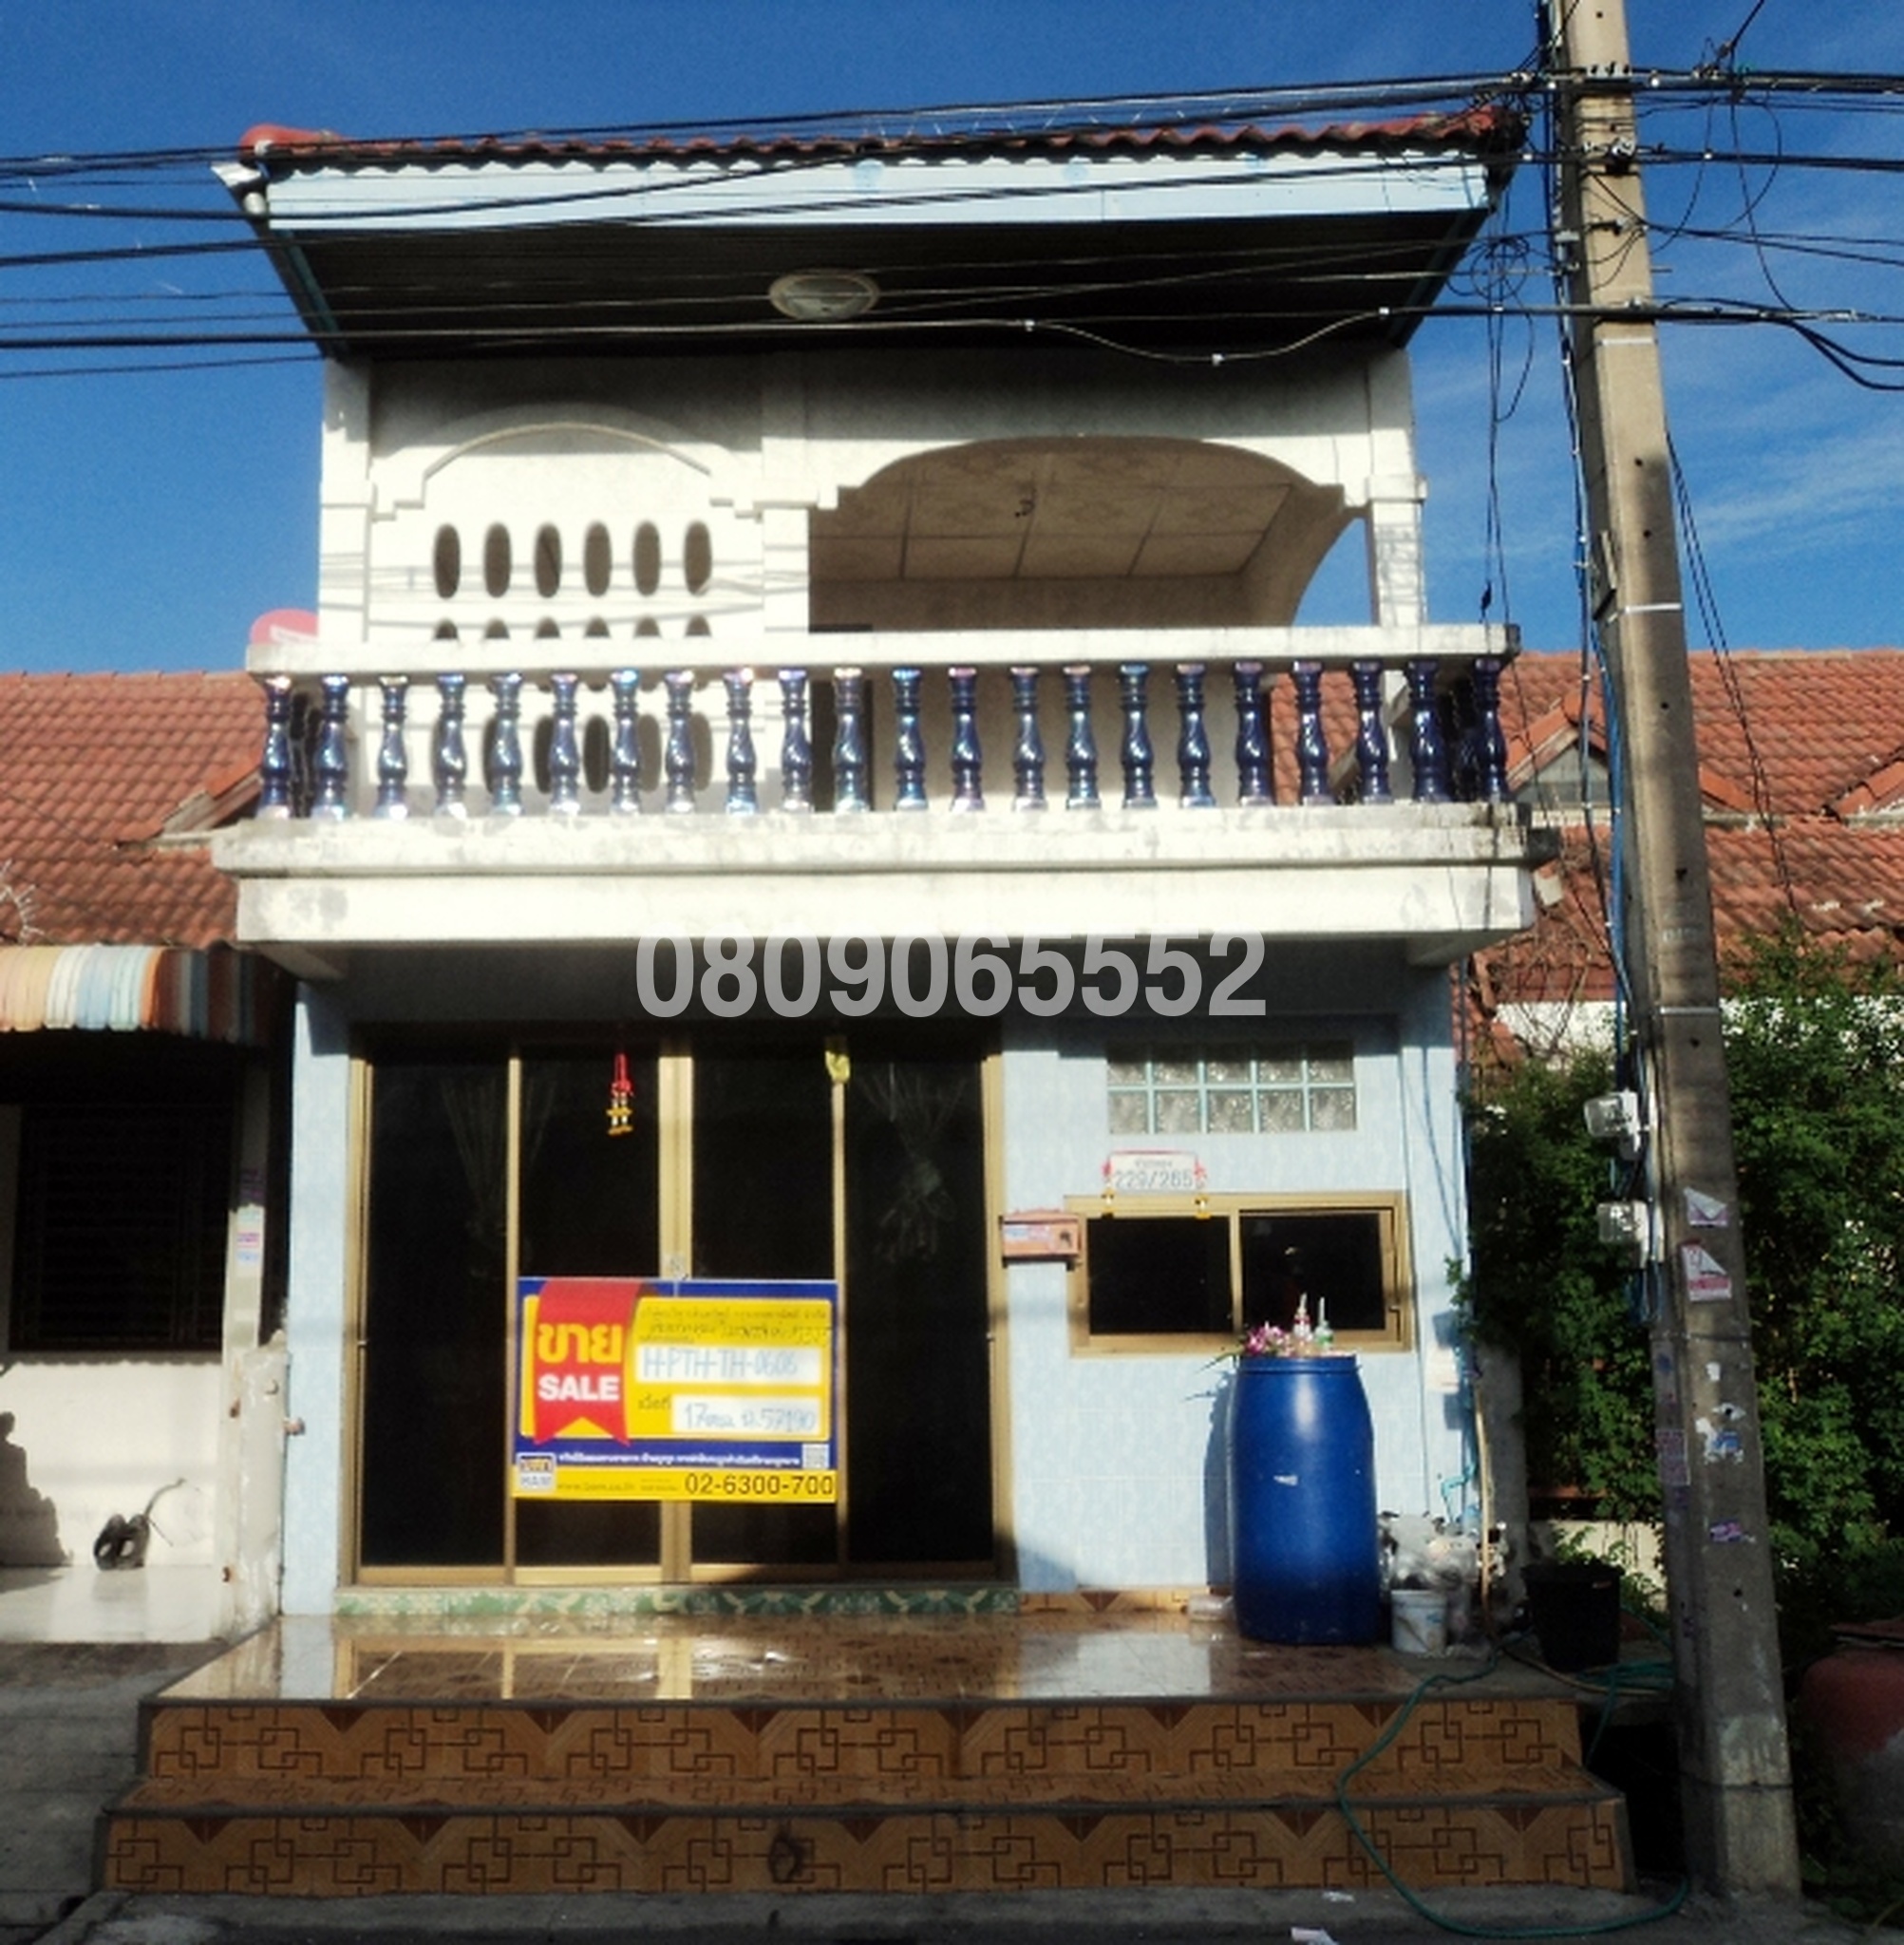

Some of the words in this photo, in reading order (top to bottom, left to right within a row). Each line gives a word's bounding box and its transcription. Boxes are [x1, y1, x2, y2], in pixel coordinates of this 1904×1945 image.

[537, 1323, 622, 1364] ขาย
[537, 1374, 620, 1402] SALE
[685, 1473, 834, 1496] 02-6300-700
